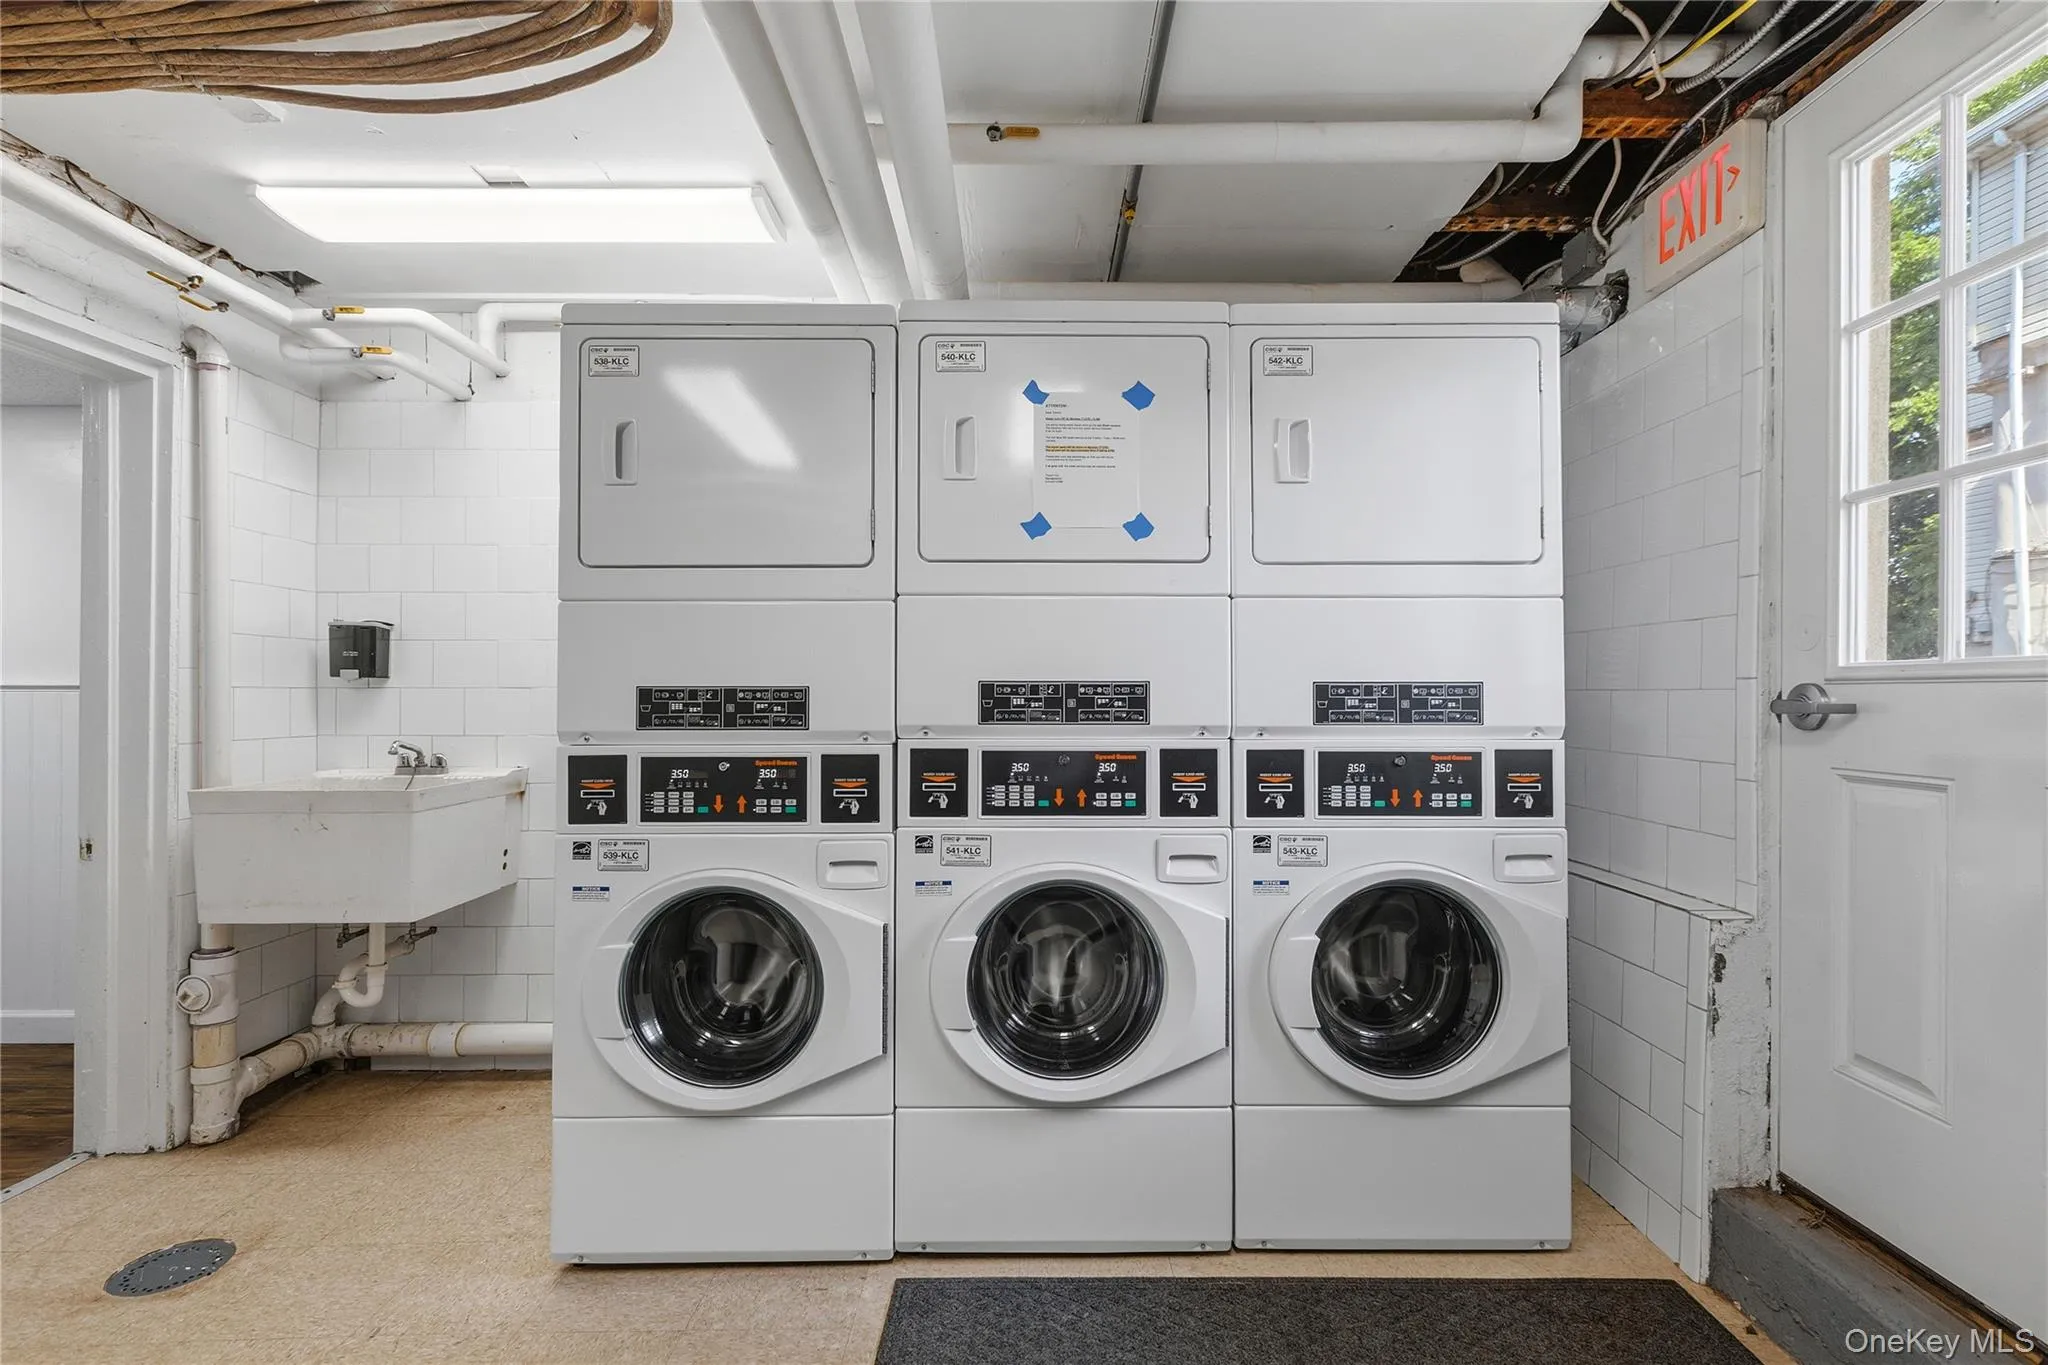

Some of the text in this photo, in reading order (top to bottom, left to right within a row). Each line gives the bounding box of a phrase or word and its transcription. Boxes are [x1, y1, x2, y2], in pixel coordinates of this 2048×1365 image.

[1659, 142, 1732, 264] EXIT
[593, 357, 629, 365] 538-KLC
[940, 352, 976, 361] 540-KLC
[1268, 356, 1304, 365] 542-KLC
[602, 851, 639, 860] 539-KLC
[945, 847, 982, 855] 541-KLC
[1282, 847, 1318, 856] 543-KLC
